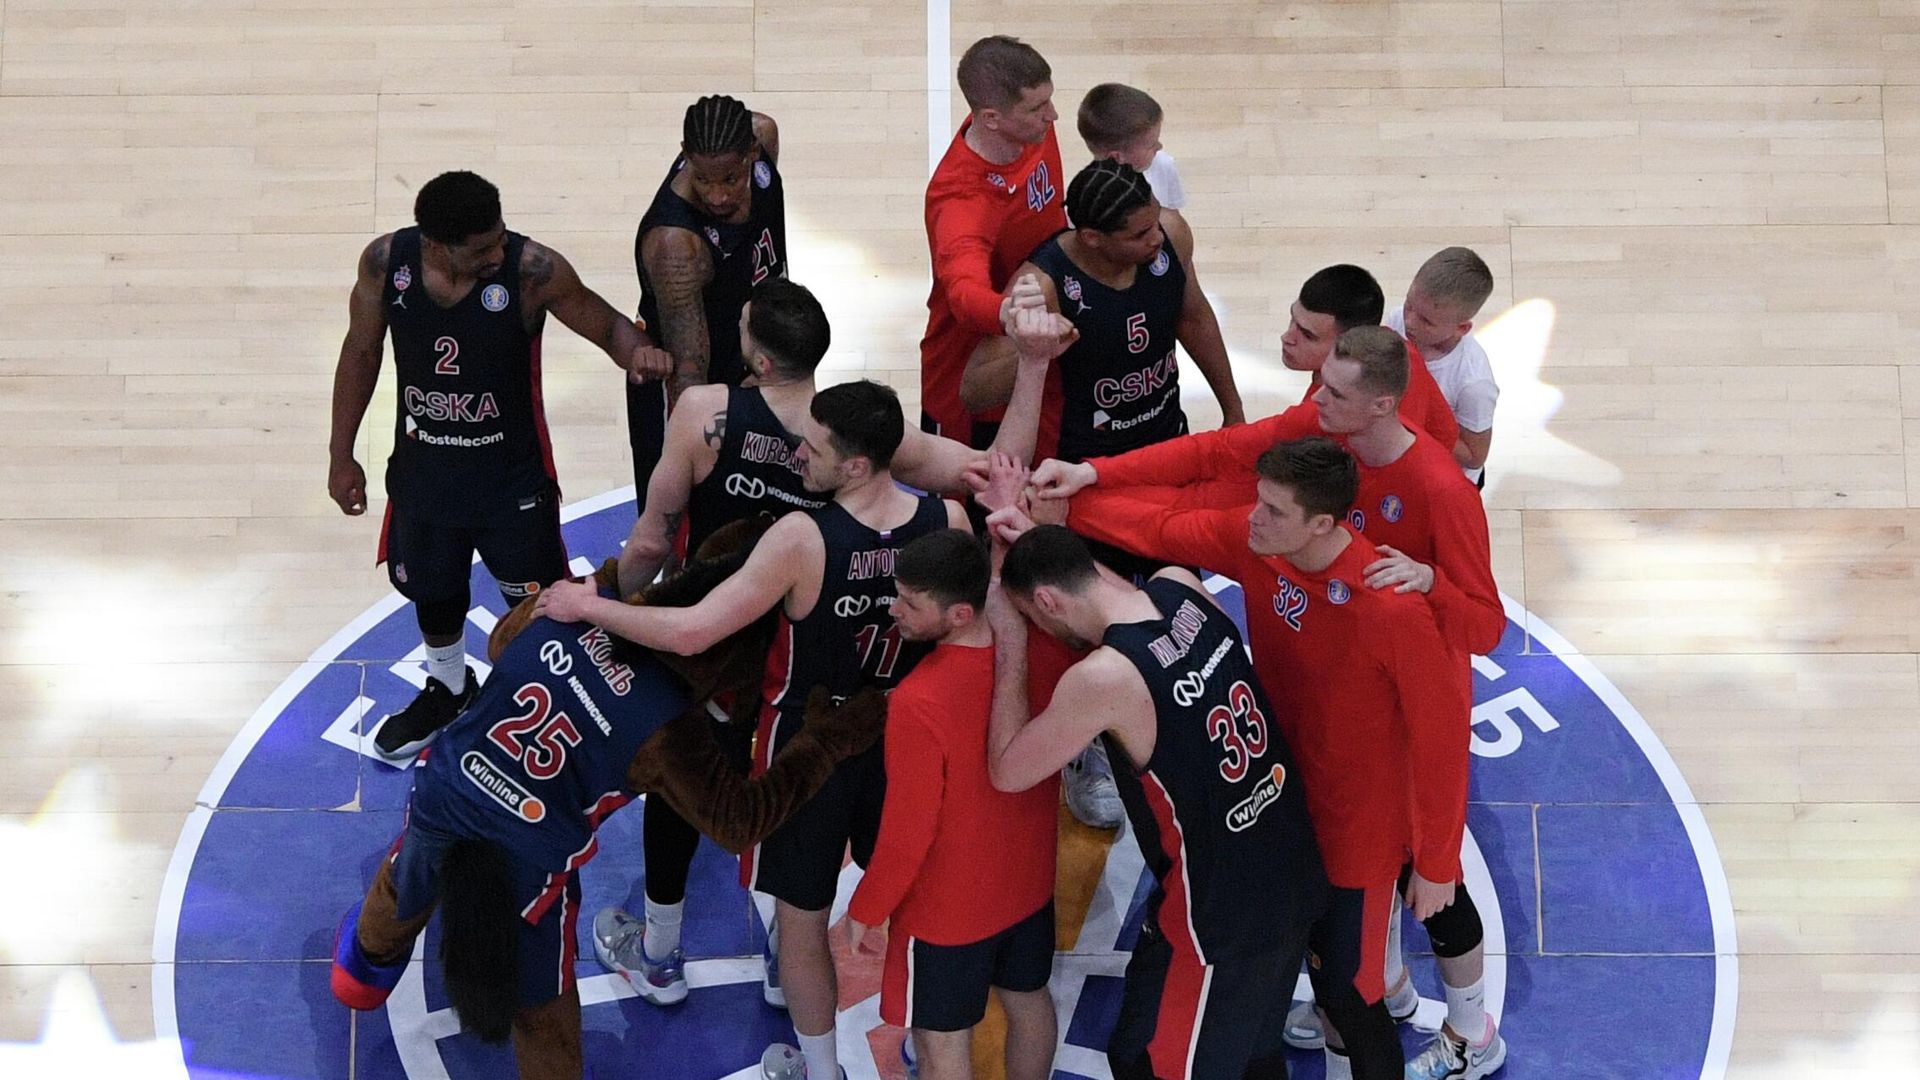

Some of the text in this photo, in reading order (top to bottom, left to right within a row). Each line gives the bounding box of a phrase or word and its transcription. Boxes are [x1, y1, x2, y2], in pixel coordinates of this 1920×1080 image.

[1027, 160, 1056, 213] 42
[751, 228, 777, 287] 21
[434, 335, 460, 375] 2
[1126, 312, 1149, 353] 5
[404, 385, 500, 423] CSKA
[1094, 349, 1177, 408] CSKA
[418, 429, 504, 447] Rostelecom
[1272, 574, 1309, 632] 32
[486, 682, 583, 780] 25
[567, 675, 612, 737] NORNICKEL
[1206, 680, 1268, 783] 33
[469, 757, 520, 806] Winline
